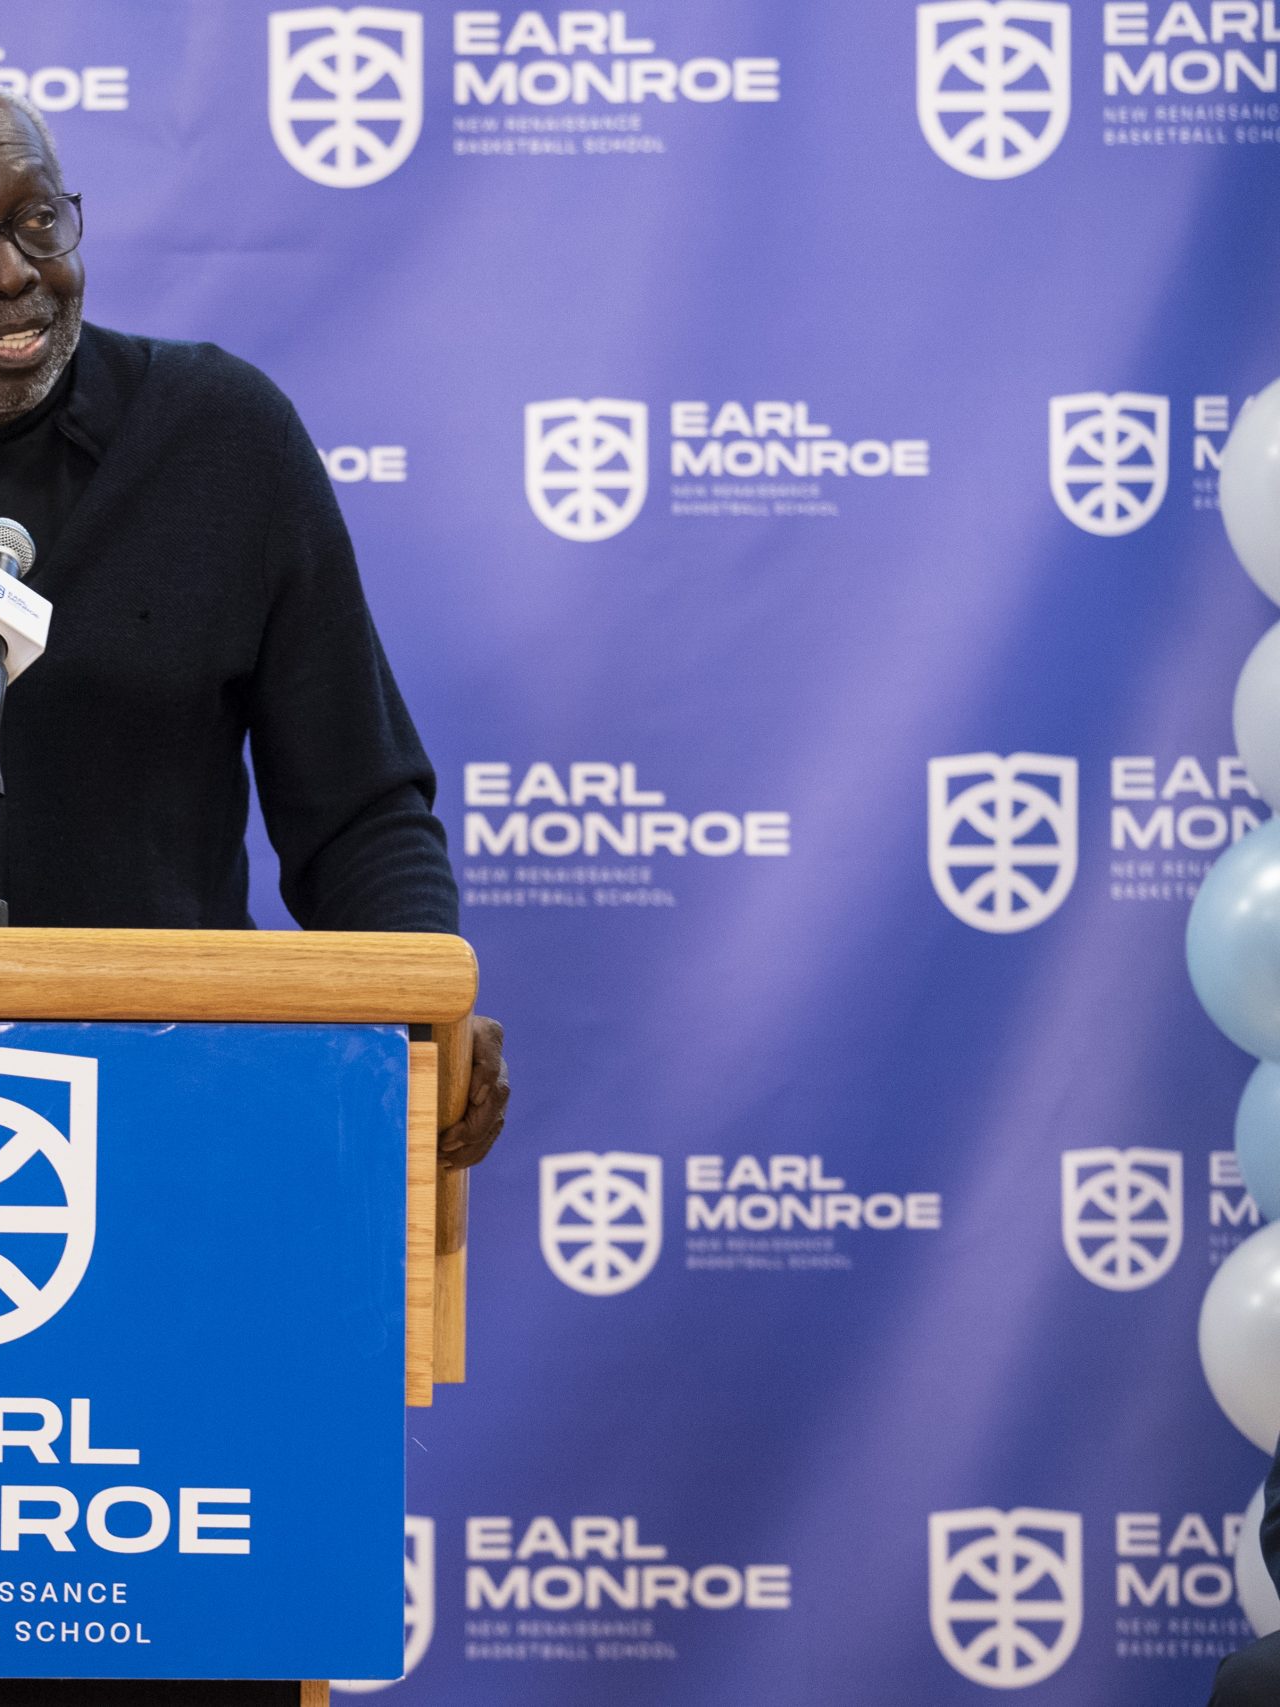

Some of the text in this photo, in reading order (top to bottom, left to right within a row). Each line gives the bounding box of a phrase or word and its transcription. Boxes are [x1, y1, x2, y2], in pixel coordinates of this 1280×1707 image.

[453, 10, 655, 56] EARL
[453, 57, 780, 106] MONROE
[670, 401, 831, 438] EARL
[670, 439, 929, 477] MONROE
[464, 762, 666, 806] EARL
[464, 811, 790, 857] MONROE
[685, 1154, 845, 1191] EARL
[686, 1193, 941, 1231] MONROE
[466, 1516, 667, 1561] EARL
[466, 1565, 791, 1610] MONROE
[14, 1620, 151, 1644] SCHOOL
